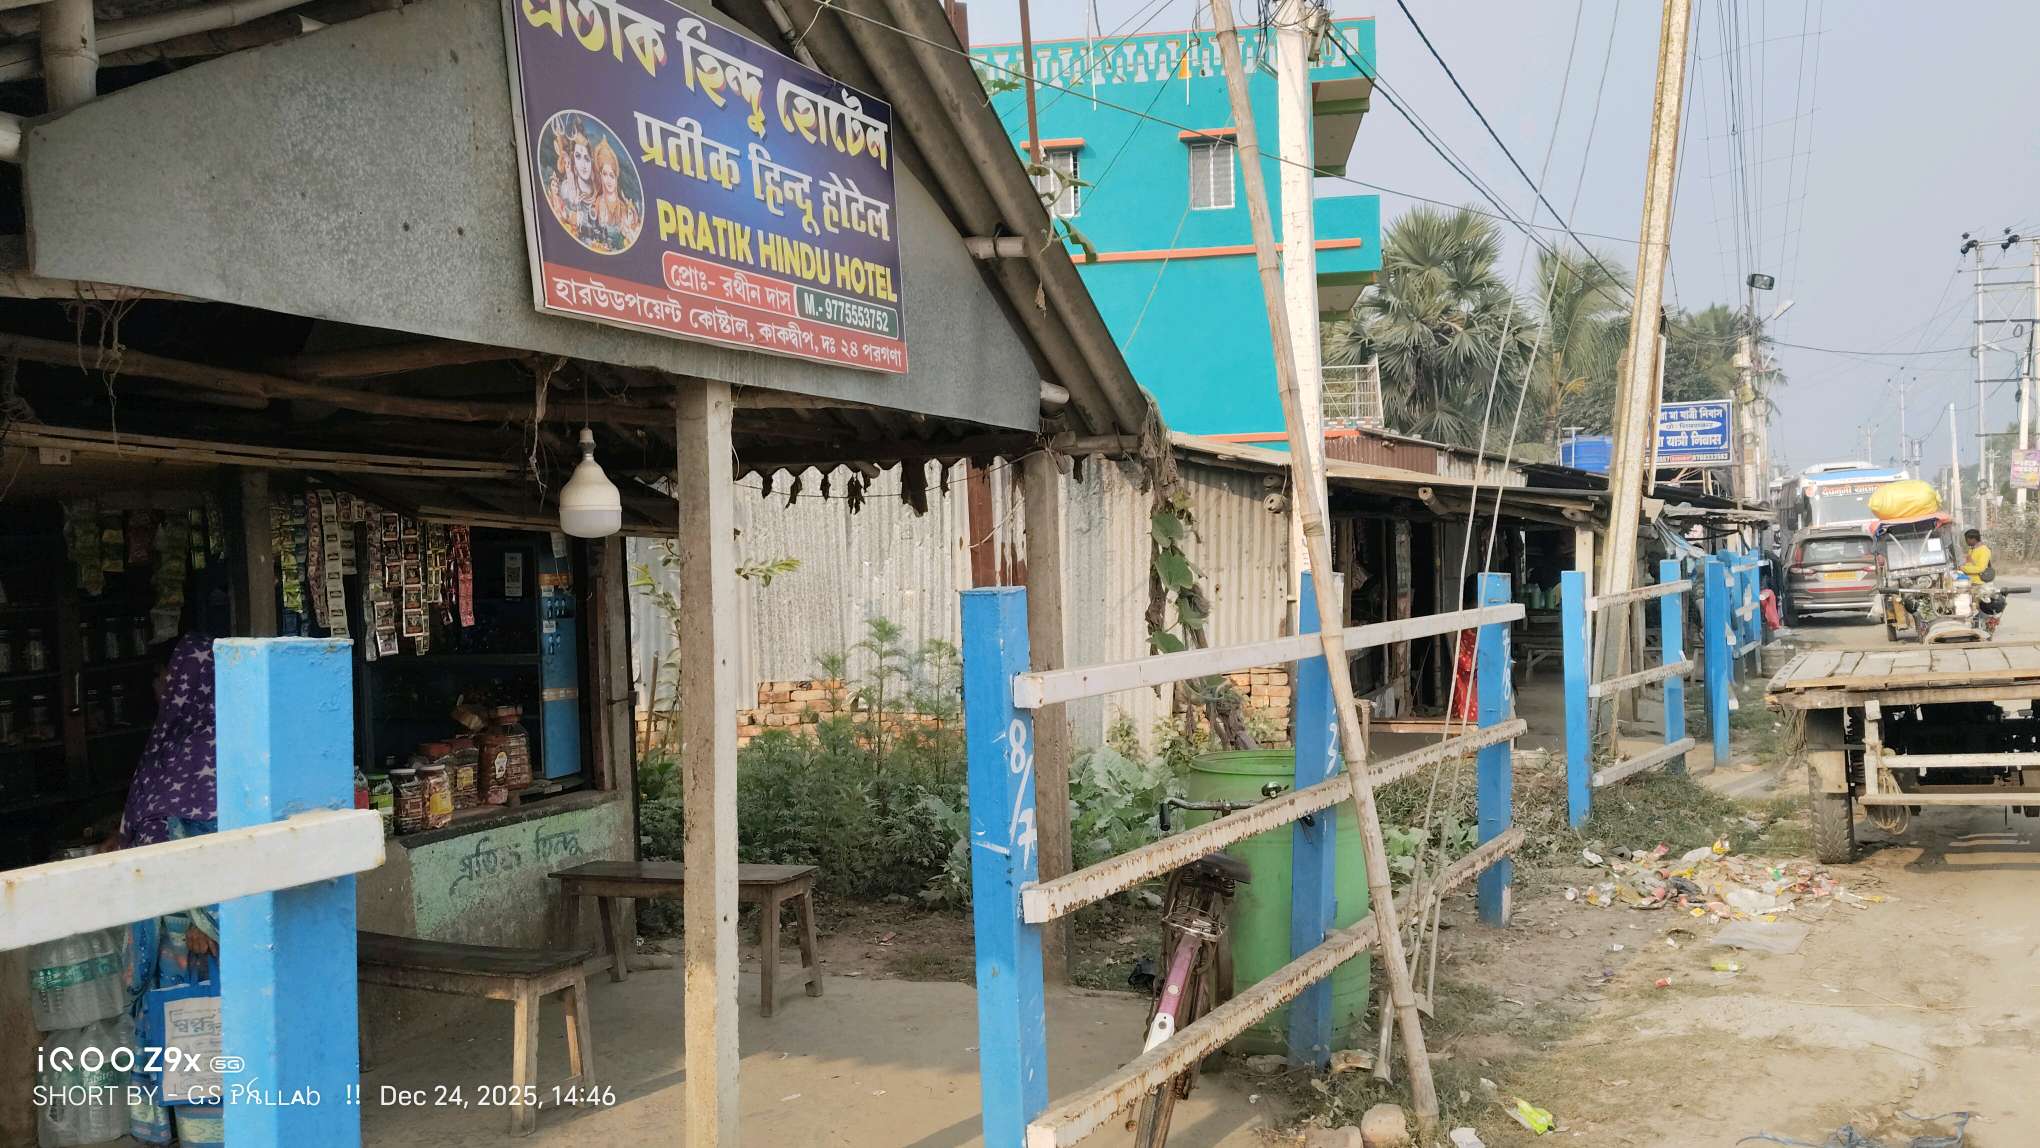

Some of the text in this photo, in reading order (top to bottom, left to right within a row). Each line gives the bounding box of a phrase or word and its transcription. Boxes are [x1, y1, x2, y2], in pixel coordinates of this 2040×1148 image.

[676, 17, 763, 138] হিন্দু
[776, 78, 888, 169] হোটেল
[633, 111, 890, 241] प्रतीक हिन्दू होटेल
[656, 198, 898, 302] PRATIK HINDU HOTEL
[719, 271, 761, 304] রথীন
[764, 286, 792, 312] দাস
[552, 276, 682, 322] হারউডপয়েন্ট
[821, 335, 836, 354] দঃ
[841, 338, 858, 358] ২৪
[862, 343, 902, 367] পরগণা
[824, 297, 889, 332] 9775553752
